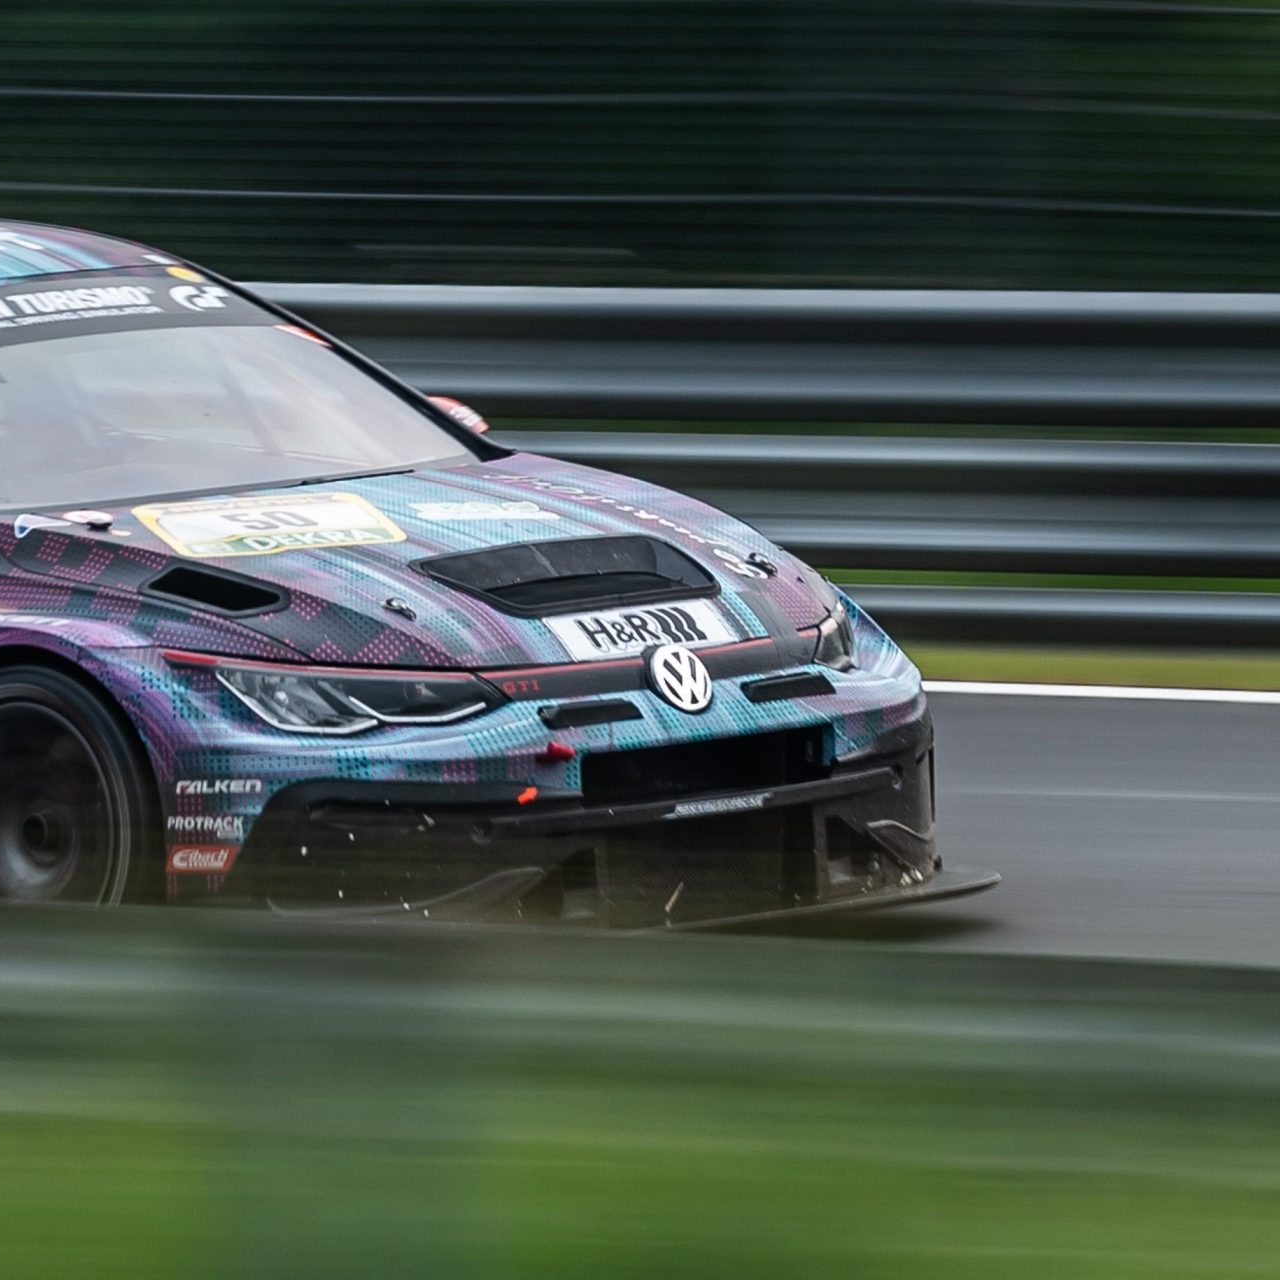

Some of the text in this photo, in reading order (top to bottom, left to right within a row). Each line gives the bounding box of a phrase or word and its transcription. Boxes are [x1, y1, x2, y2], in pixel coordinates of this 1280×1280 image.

[222, 510, 320, 531] 50
[243, 528, 384, 551] DEKRA
[573, 613, 666, 648] H&R
[501, 678, 541, 695] GTI
[176, 779, 262, 795] FALKEN
[167, 816, 244, 839] PROTRACK
